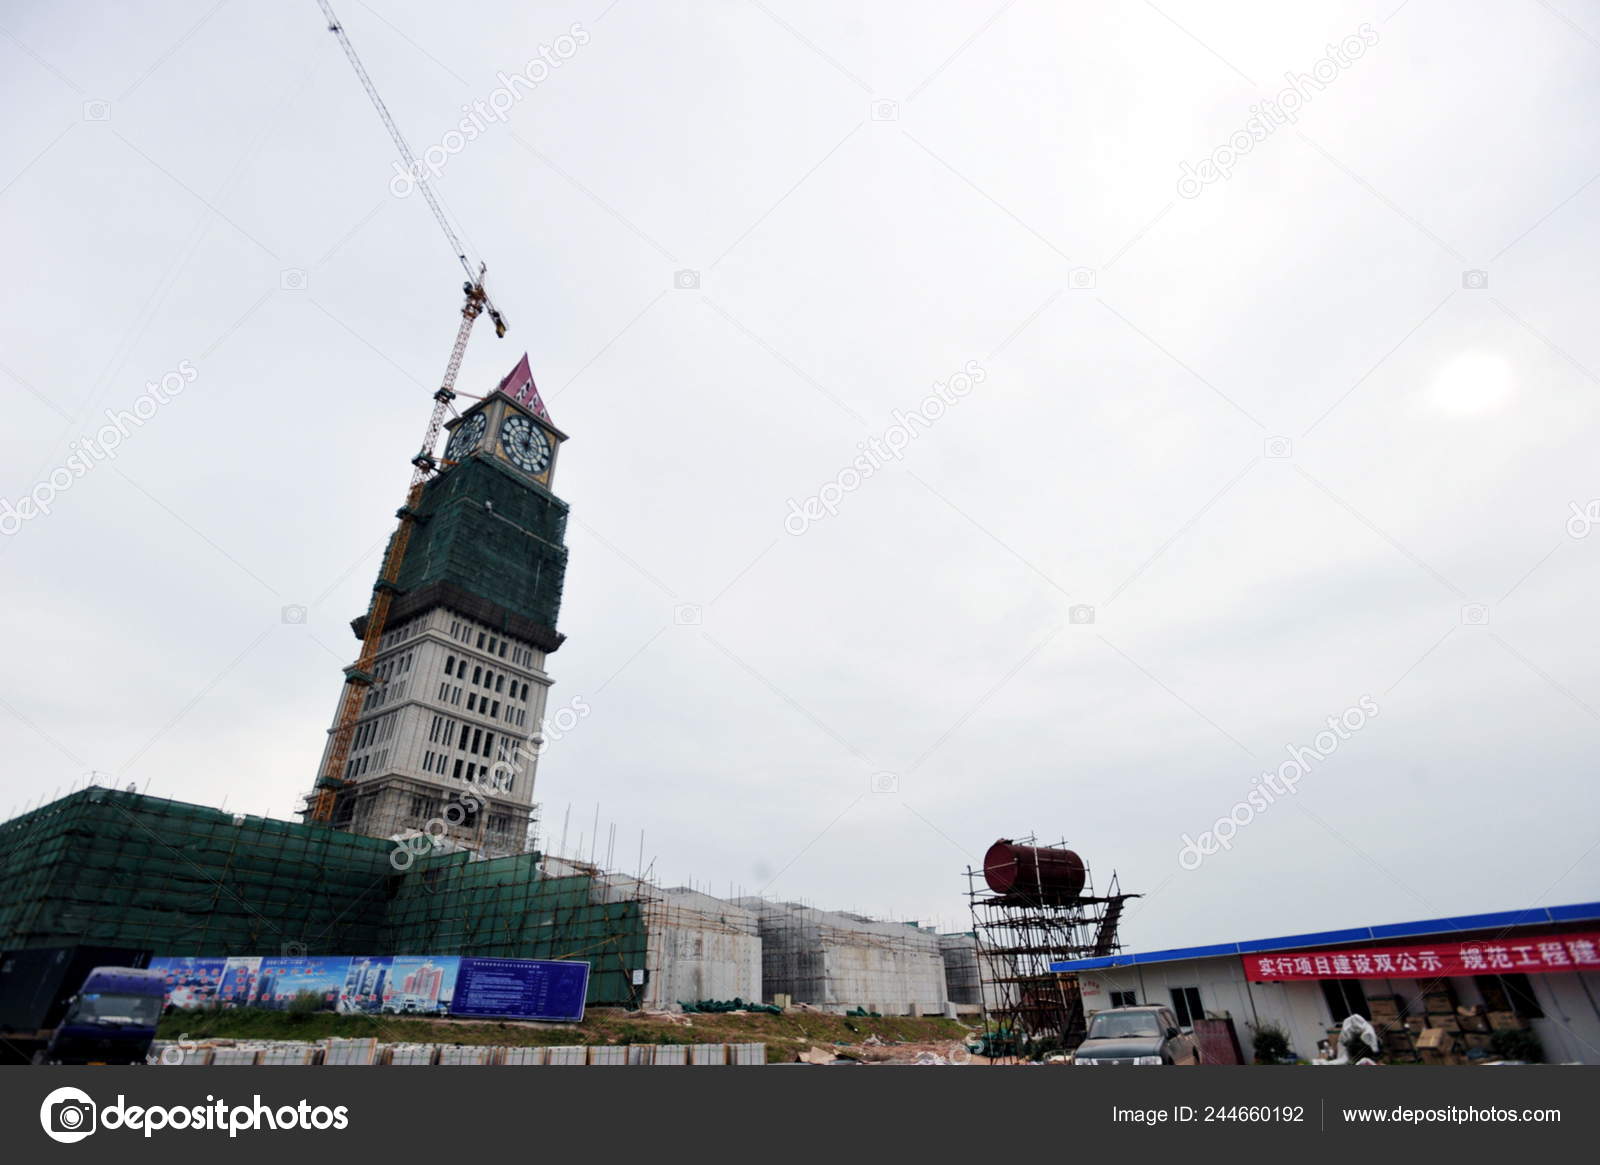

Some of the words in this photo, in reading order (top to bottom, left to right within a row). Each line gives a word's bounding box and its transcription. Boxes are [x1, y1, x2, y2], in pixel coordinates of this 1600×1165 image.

[1258, 951, 1442, 976] 实行项目建设双公示
